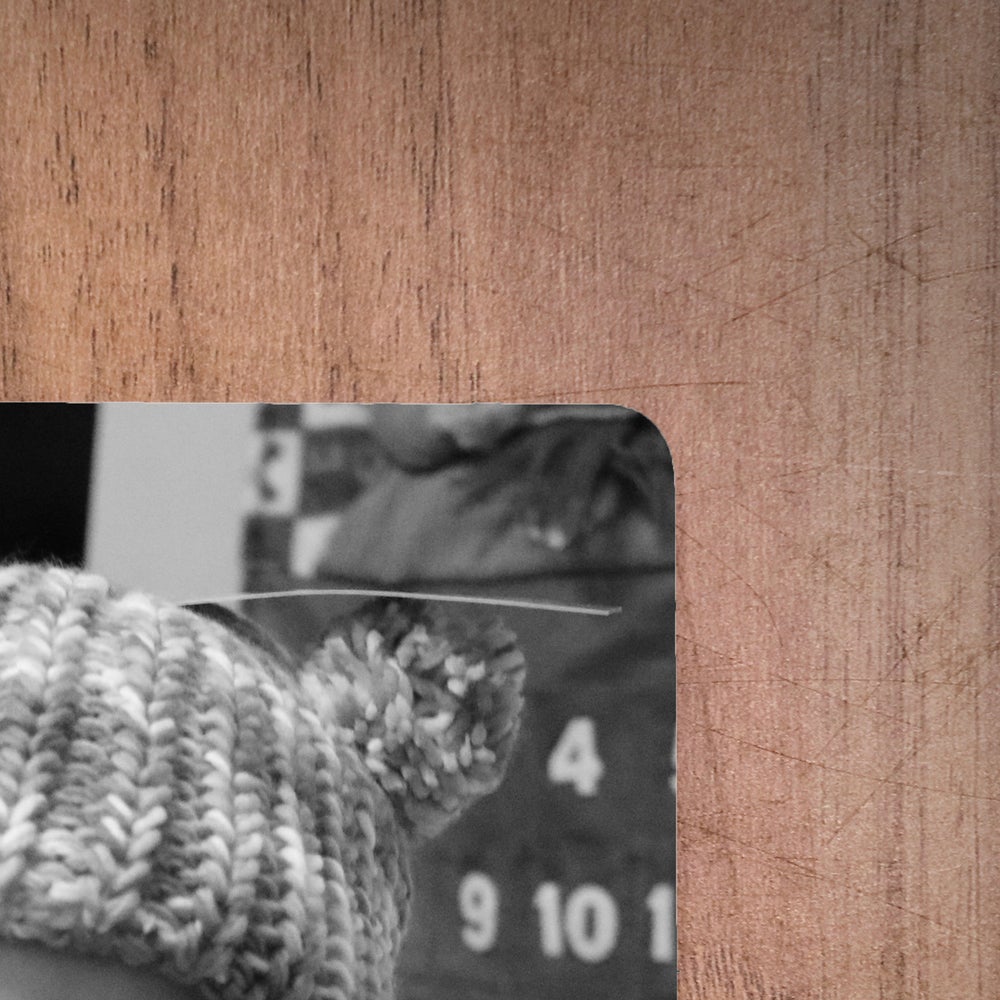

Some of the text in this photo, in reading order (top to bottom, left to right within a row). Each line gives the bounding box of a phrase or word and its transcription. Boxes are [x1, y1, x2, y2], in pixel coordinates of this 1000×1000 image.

[547, 717, 604, 797] 4
[458, 872, 499, 952] 9
[533, 882, 619, 963] 10
